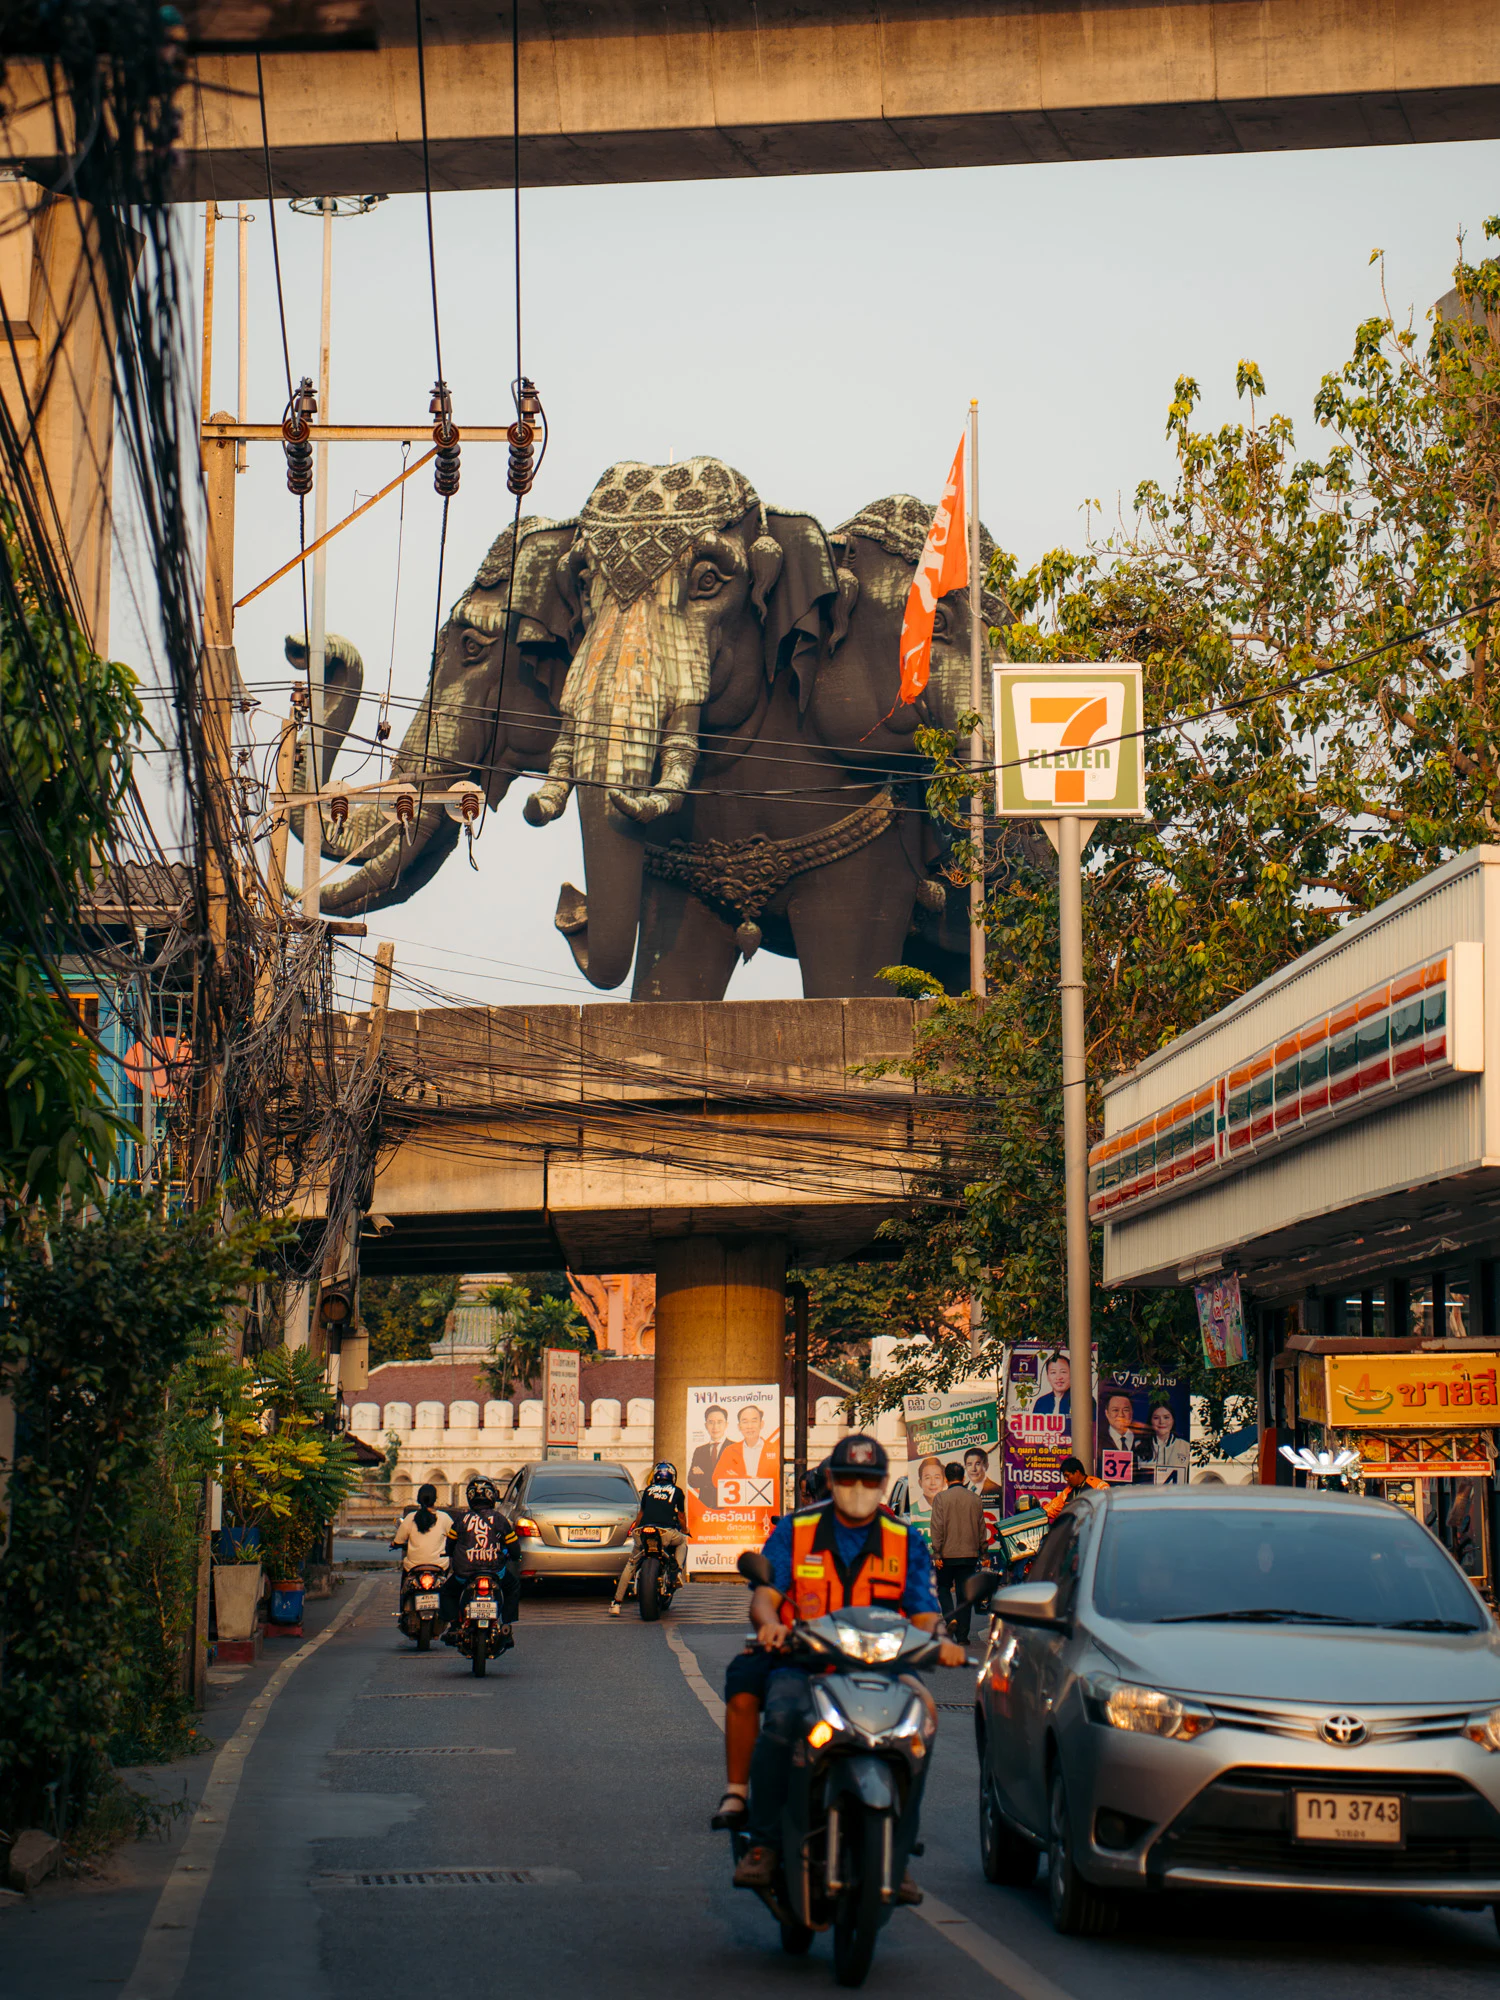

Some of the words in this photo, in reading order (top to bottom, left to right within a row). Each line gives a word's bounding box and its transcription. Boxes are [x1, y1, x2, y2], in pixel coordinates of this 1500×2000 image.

[1030, 696, 1107, 803] 7
[694, 1391, 718, 1404] พท
[719, 1391, 774, 1403] พรรคเพื่อไทย
[1009, 1413, 1064, 1437] สุเทพ
[1104, 1459, 1131, 1478] 37
[723, 1481, 741, 1504] 3
[695, 1550, 736, 1565] เพื่อไทย
[1308, 1798, 1337, 1820] กว
[1349, 1800, 1399, 1823] 3743
